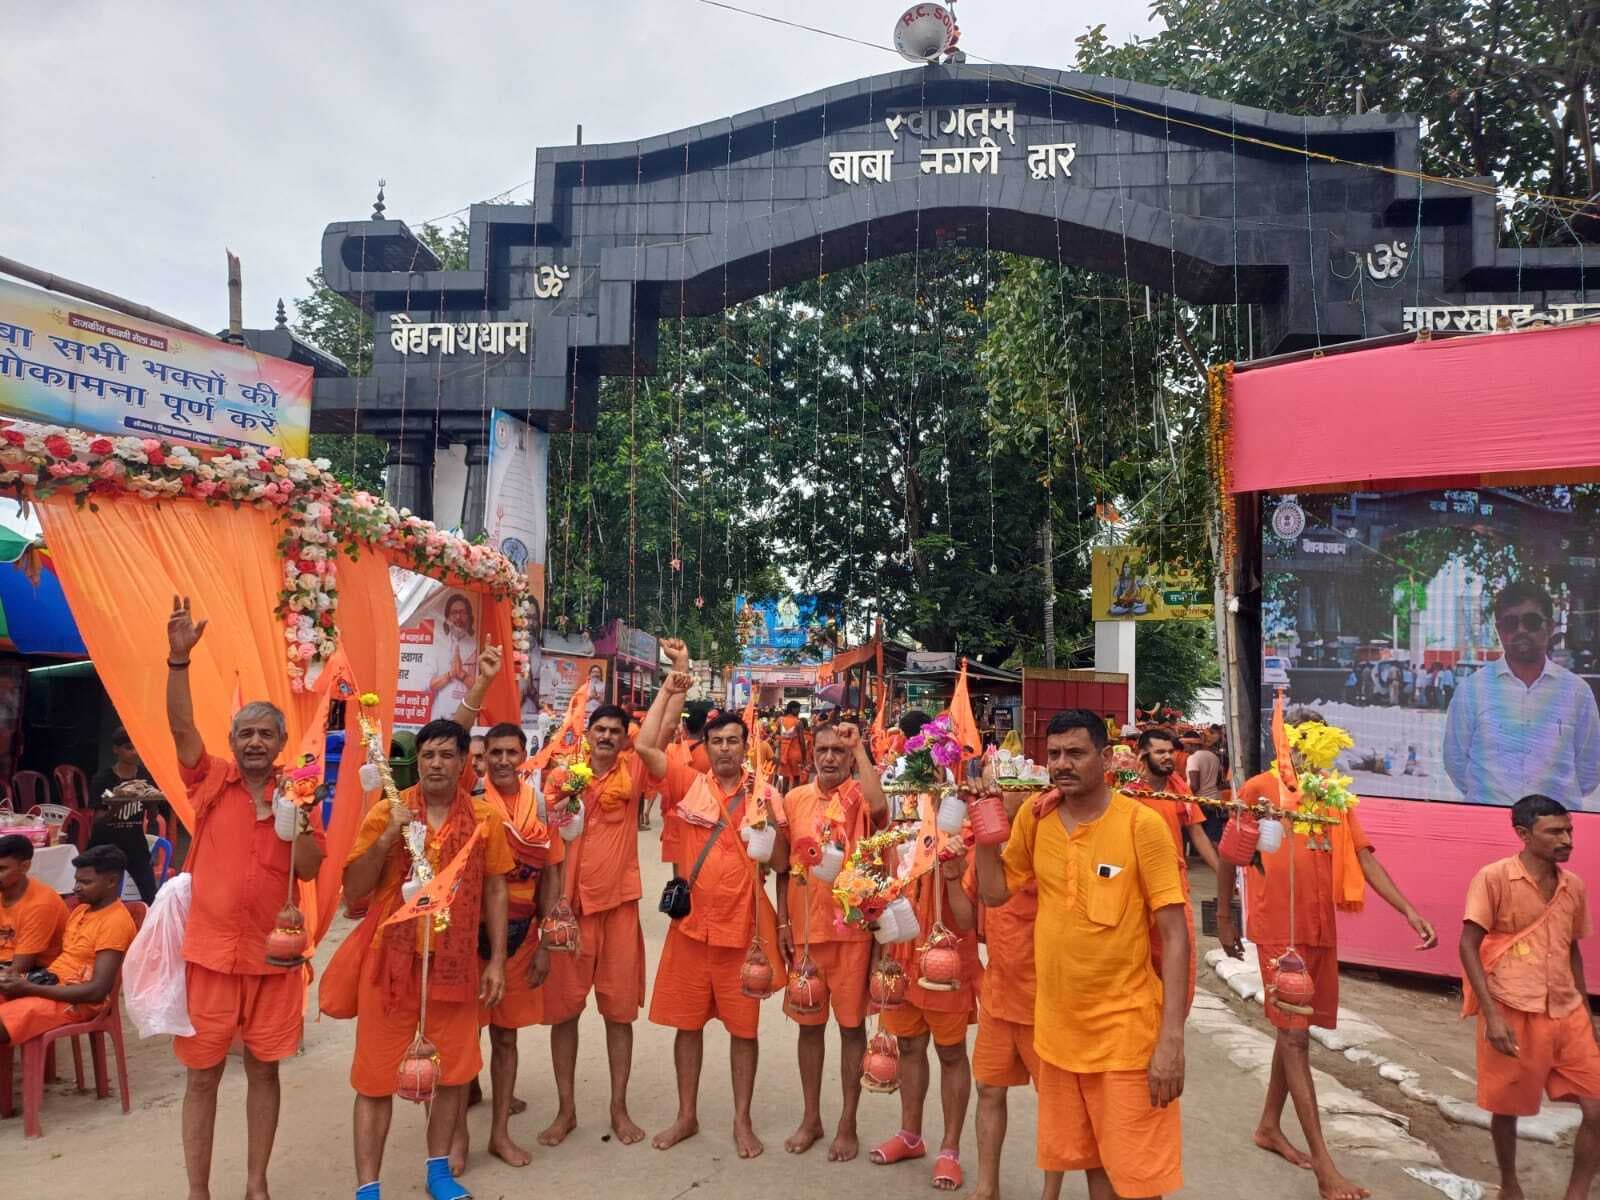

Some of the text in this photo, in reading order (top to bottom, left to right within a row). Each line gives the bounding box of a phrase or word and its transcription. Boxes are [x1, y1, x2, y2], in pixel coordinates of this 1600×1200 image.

[828, 136, 1076, 184] बाबा नगरी द्वार
[48, 335, 129, 373] सभी
[142, 359, 228, 396] भक्तों
[238, 382, 279, 408] की
[160, 393, 216, 423] पूर्ण
[227, 409, 279, 434] करें
[401, 652, 424, 664] स्वागत
